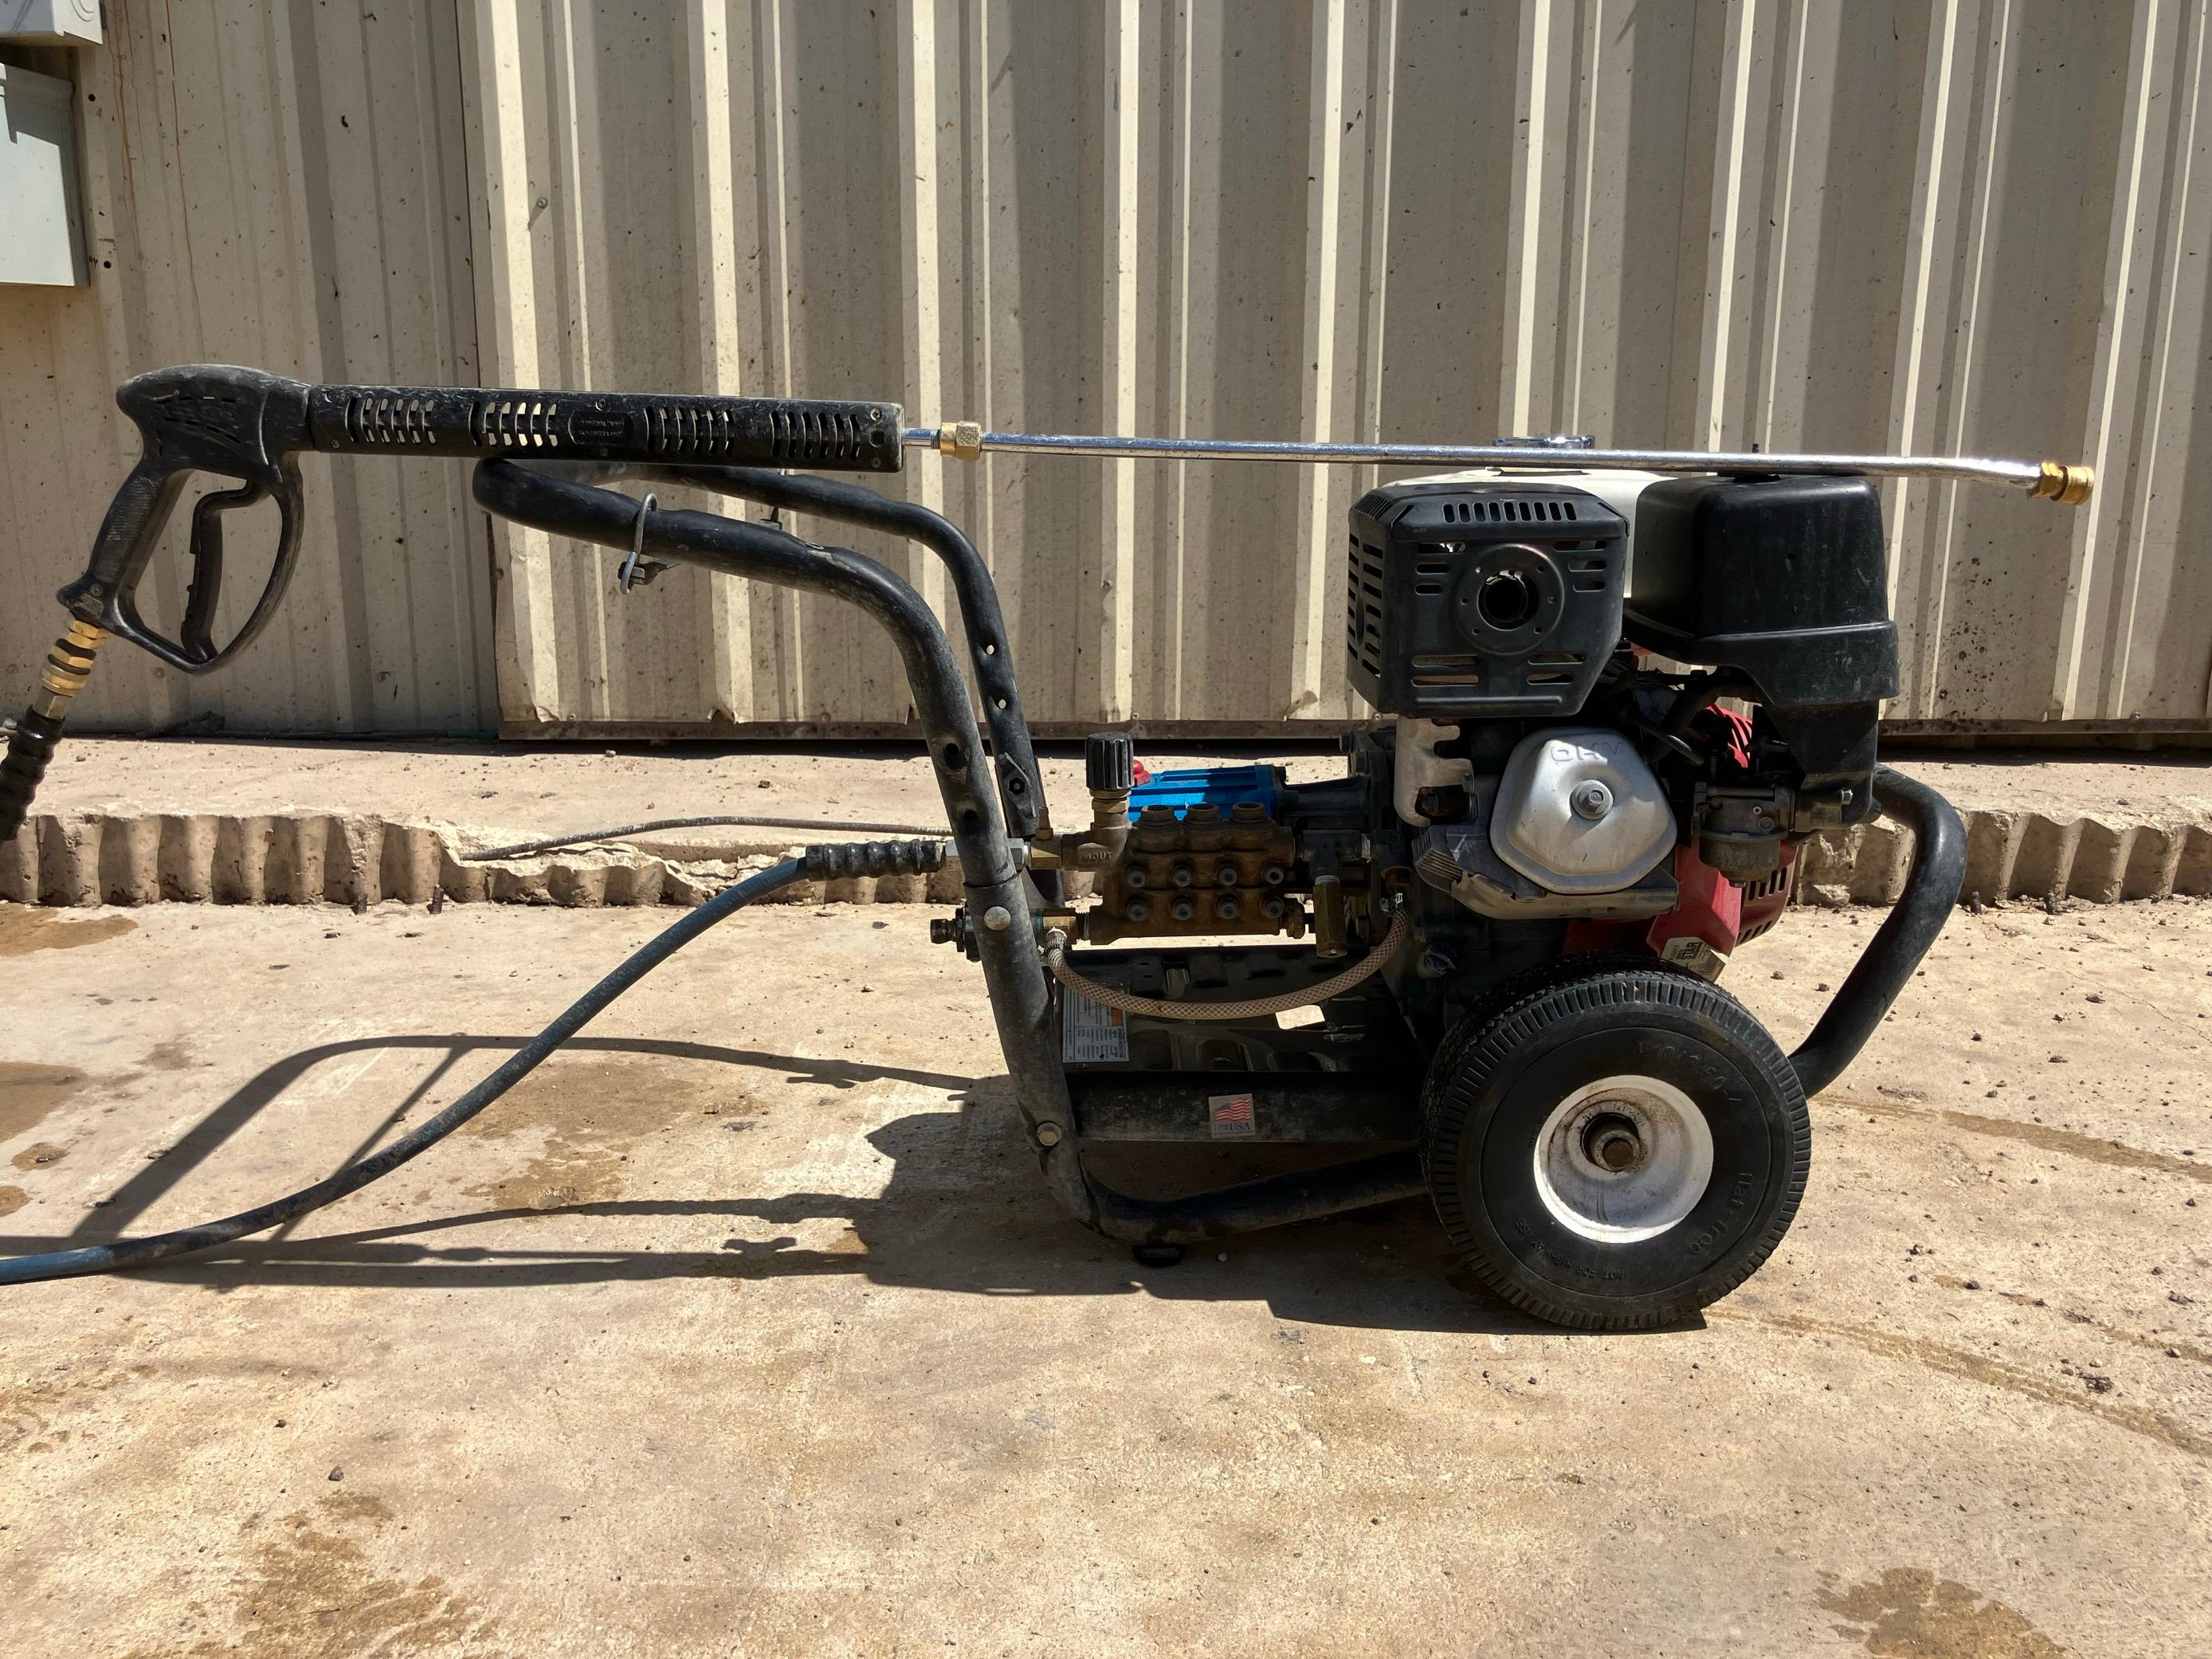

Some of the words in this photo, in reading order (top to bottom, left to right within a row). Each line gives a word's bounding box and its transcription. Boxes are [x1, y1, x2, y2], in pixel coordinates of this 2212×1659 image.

[1551, 741, 1625, 763] OHV
[1229, 1121, 1252, 1131] USA
[1575, 1262, 1596, 1279] FOR
[1601, 1267, 1624, 1283] NOT
